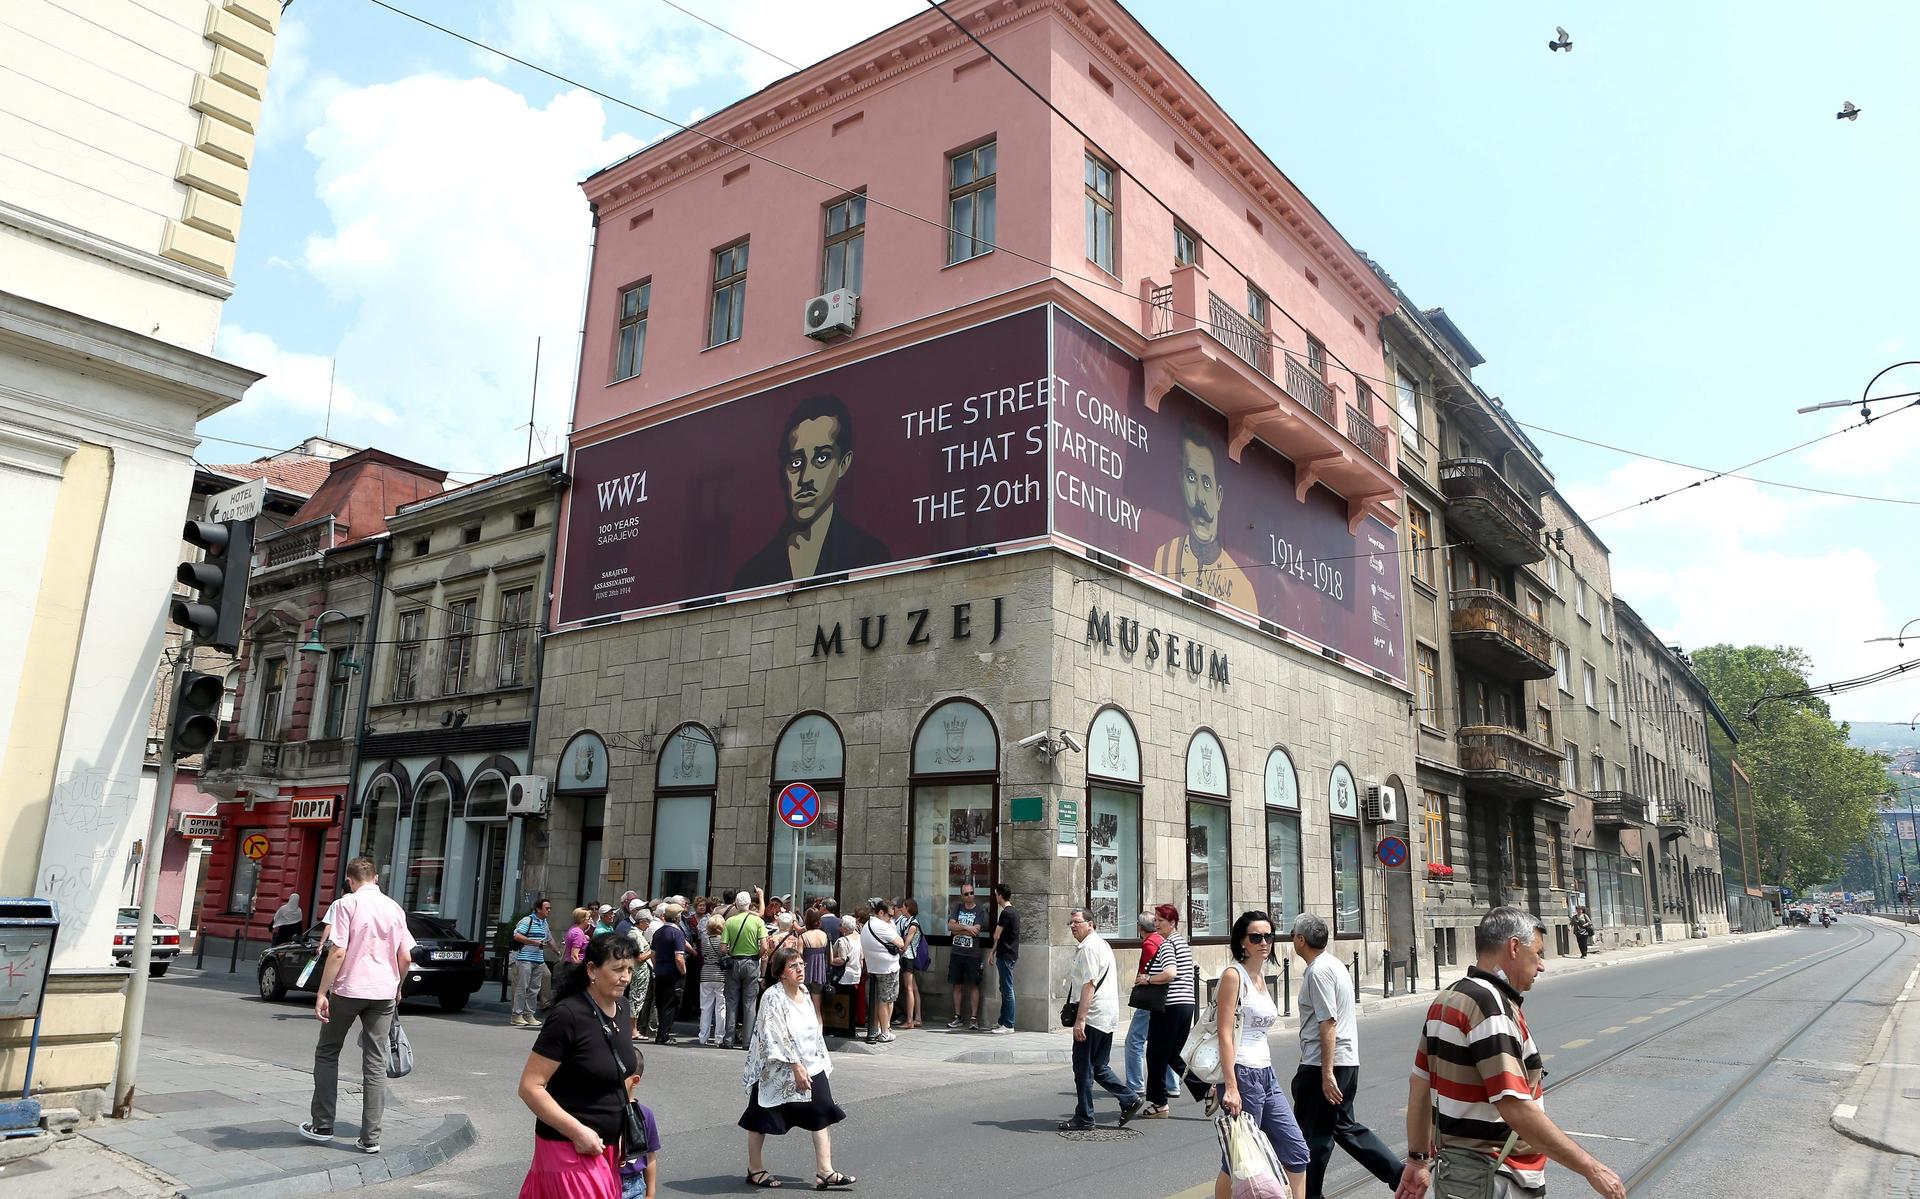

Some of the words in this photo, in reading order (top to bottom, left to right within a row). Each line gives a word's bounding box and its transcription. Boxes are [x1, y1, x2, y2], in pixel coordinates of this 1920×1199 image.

[902, 403, 952, 439] THE
[963, 375, 1070, 424] STREET
[1076, 390, 1149, 453] CORNER
[942, 431, 1015, 473] THAT
[1026, 421, 1123, 480] STARTED
[230, 488, 252, 504] HOTEL
[597, 470, 648, 513] WW1
[913, 488, 966, 524] THE
[976, 474, 1040, 513] 20th
[1056, 470, 1142, 533] CENTURY
[222, 509, 235, 521] OLD
[236, 501, 256, 516] TOWN
[599, 523, 613, 535] 100
[614, 516, 640, 531] YEARS
[597, 528, 639, 546] SARAJEVO
[1269, 533, 1343, 601] 1914-1918
[810, 597, 1004, 657] MUZEJ
[1087, 606, 1231, 685] MUSEUM
[190, 818, 219, 827] OPTIKA
[292, 801, 331, 818] DIOPTA
[189, 827, 218, 835] DIOPTA
